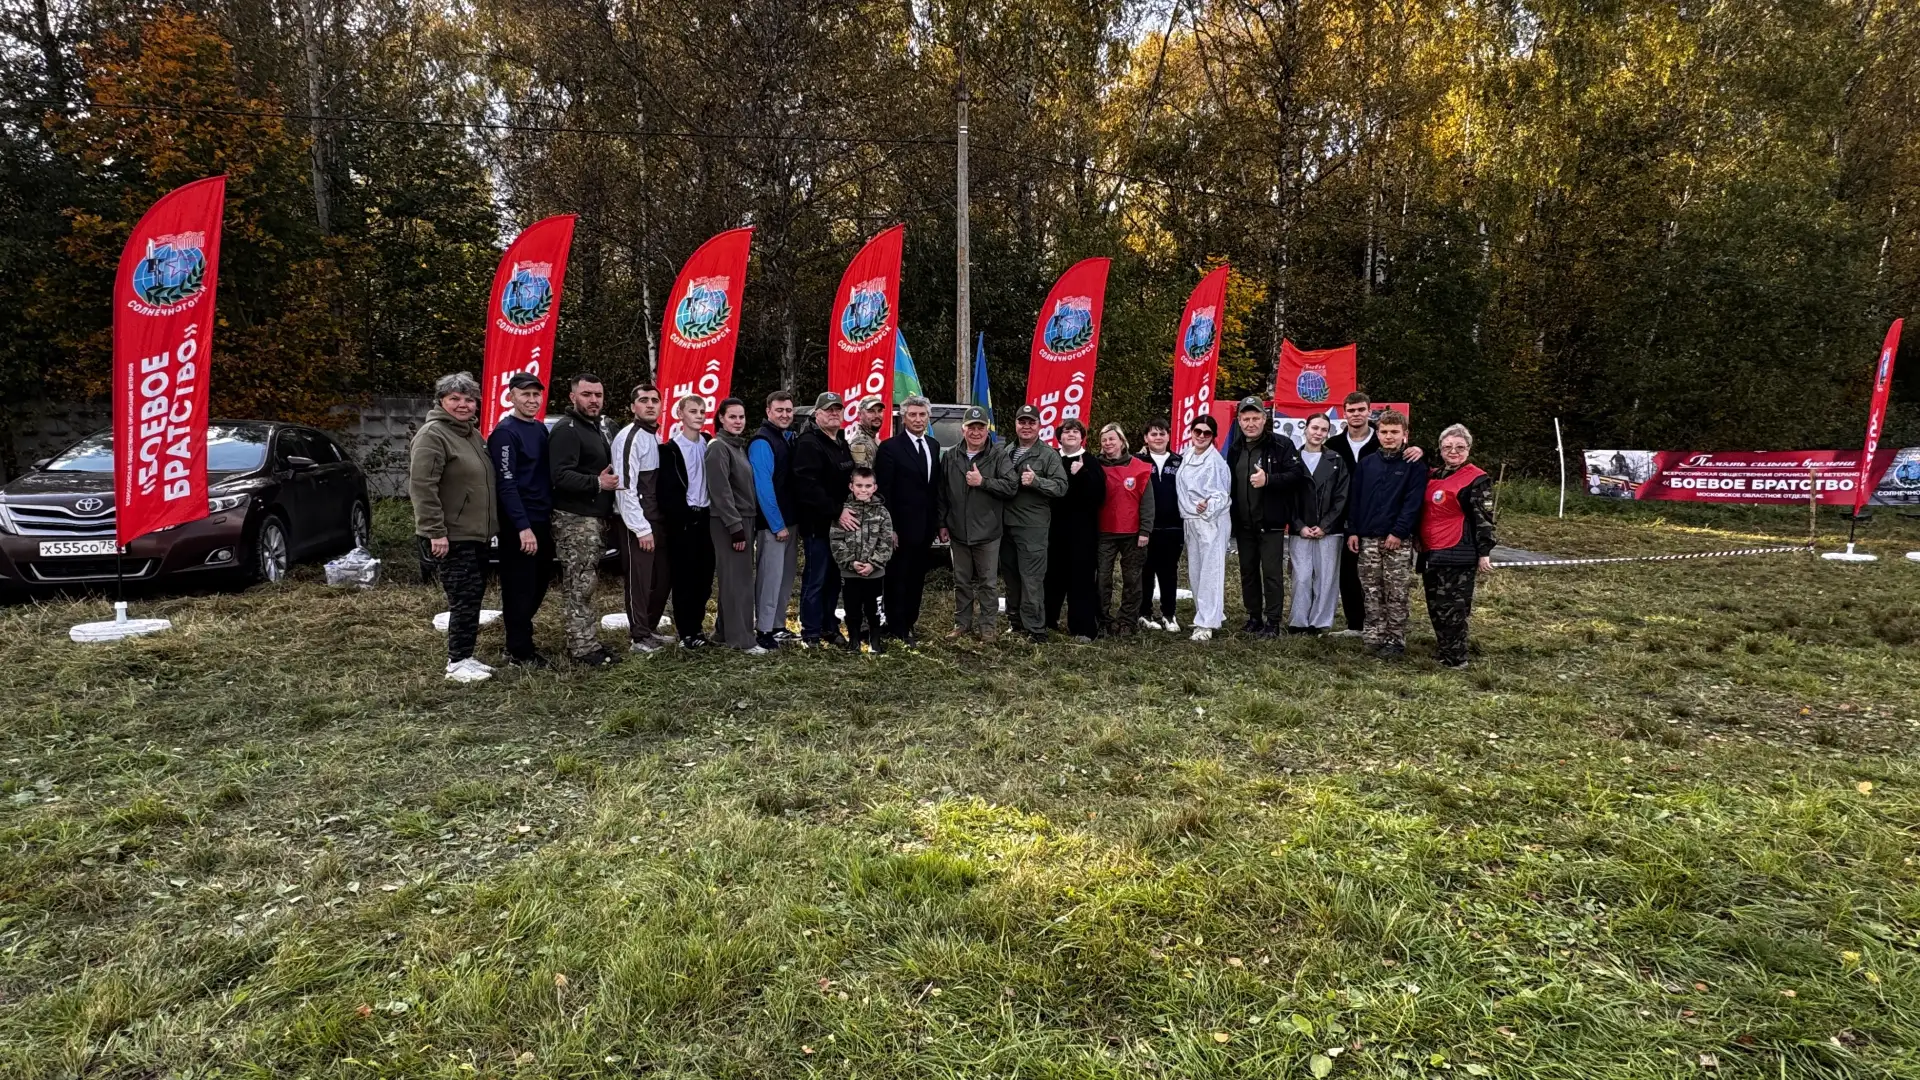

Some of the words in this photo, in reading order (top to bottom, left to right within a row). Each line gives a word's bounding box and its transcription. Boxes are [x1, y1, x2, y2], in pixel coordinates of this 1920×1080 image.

[127, 285, 207, 316] СОЛНЕЧНОГО
[164, 323, 198, 502] БРАТСТВО»
[1679, 454, 1747, 467] Память
[1802, 458, 1856, 469] времени
[1662, 478, 1746, 490] «БОЕВОЕ
